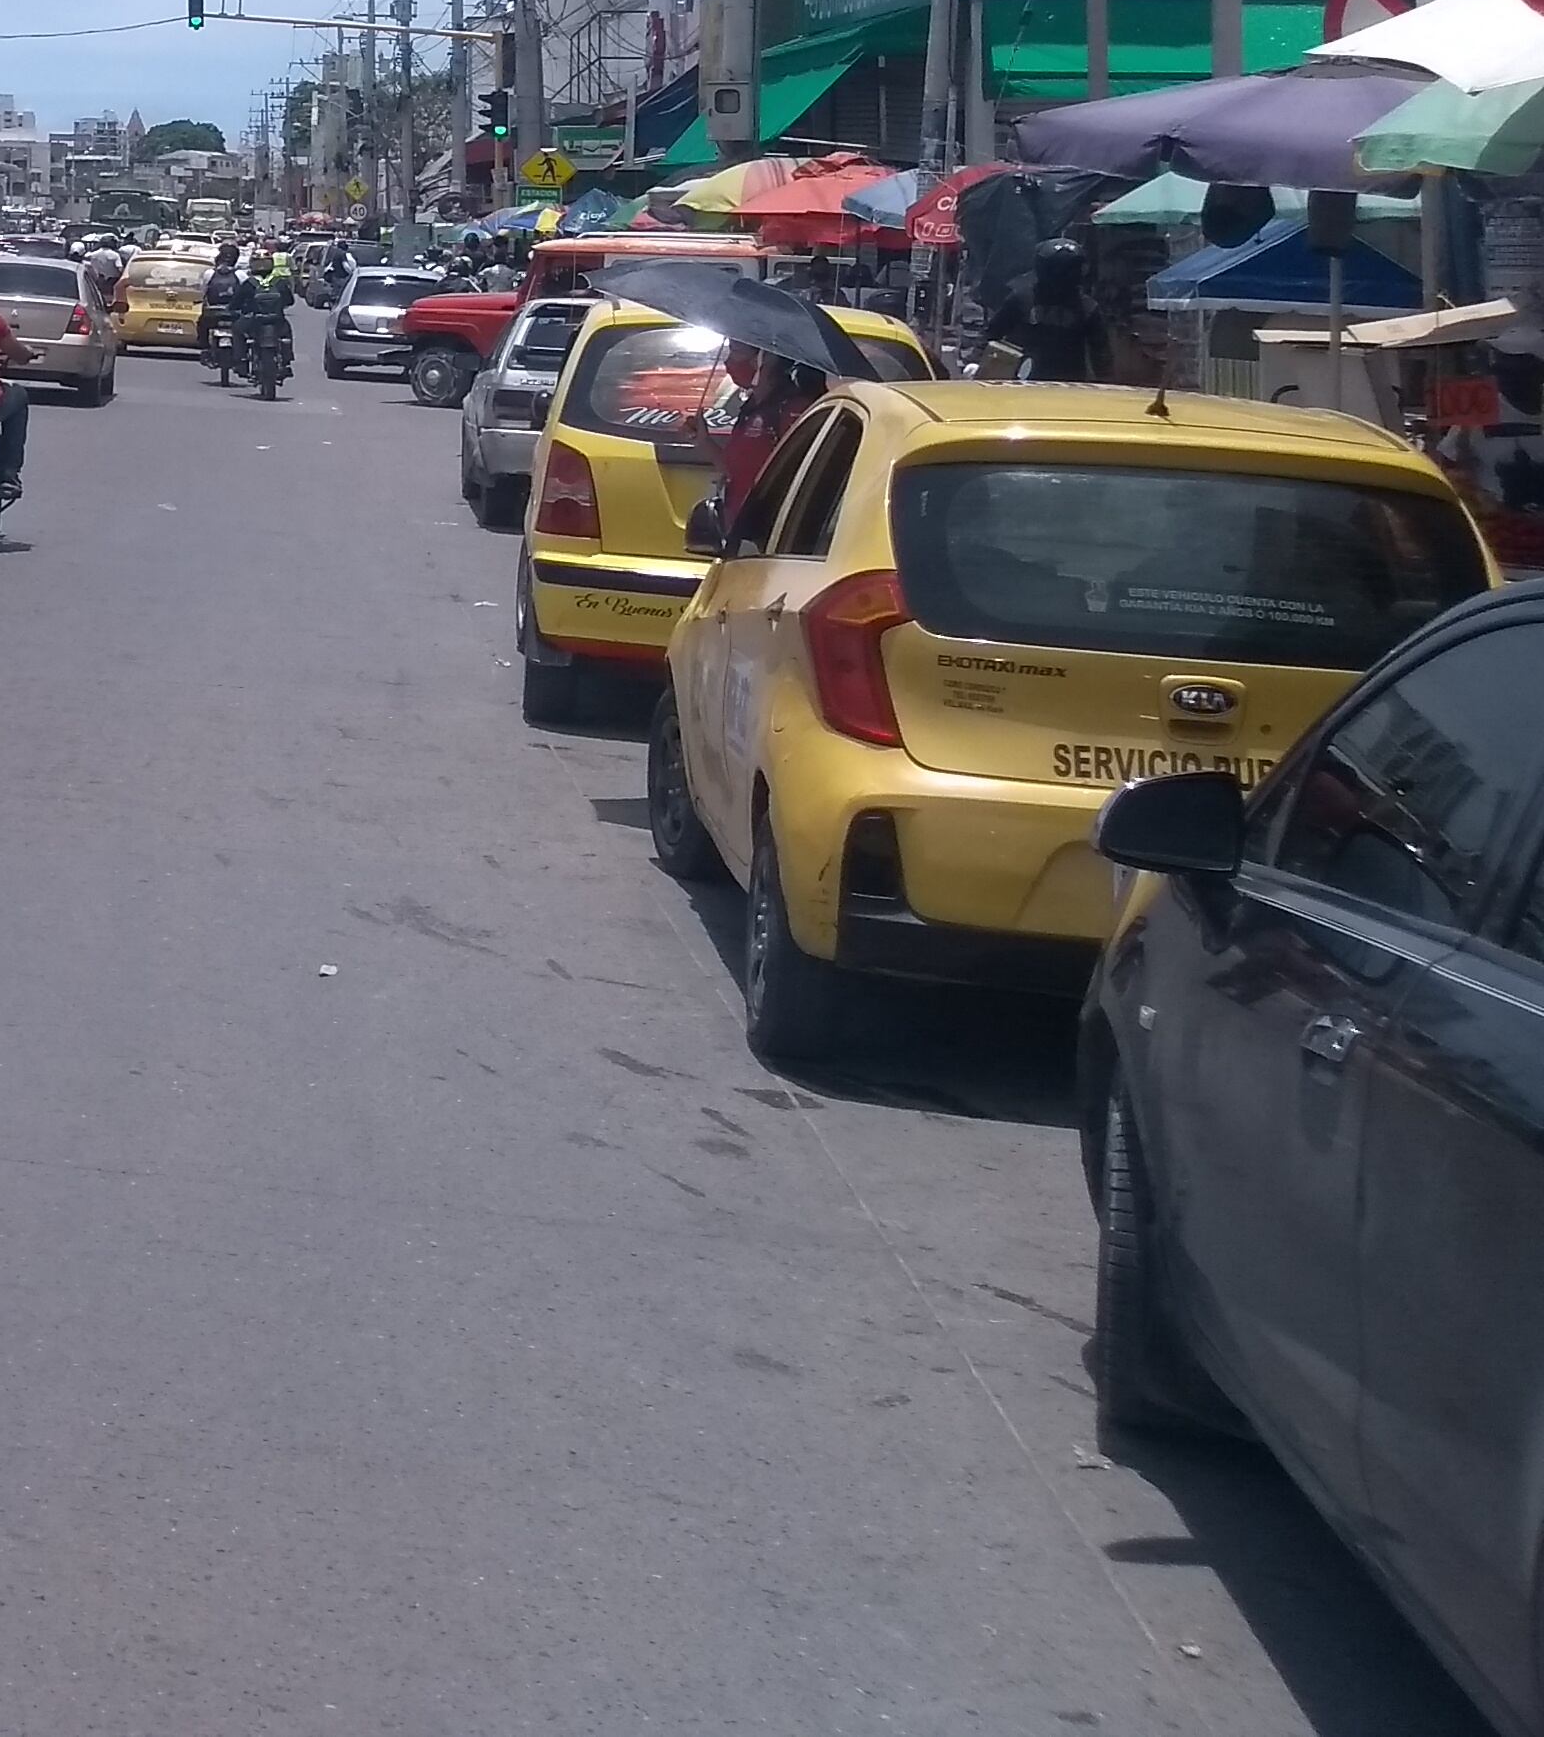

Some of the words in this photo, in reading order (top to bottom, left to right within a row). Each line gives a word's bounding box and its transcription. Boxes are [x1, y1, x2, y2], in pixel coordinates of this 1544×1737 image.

[352, 206, 365, 217] 40
[619, 405, 683, 425] Mi
[574, 593, 599, 609] En
[1127, 587, 1160, 599] ESTE
[1161, 590, 1224, 604] VEHICULO
[1226, 594, 1277, 608] CUENTA
[1278, 600, 1306, 612] CON
[1308, 603, 1325, 613] LA
[1018, 665, 1068, 678] max
[1181, 690, 1226, 709] KIA
[1053, 743, 1202, 783] SERVICIO
